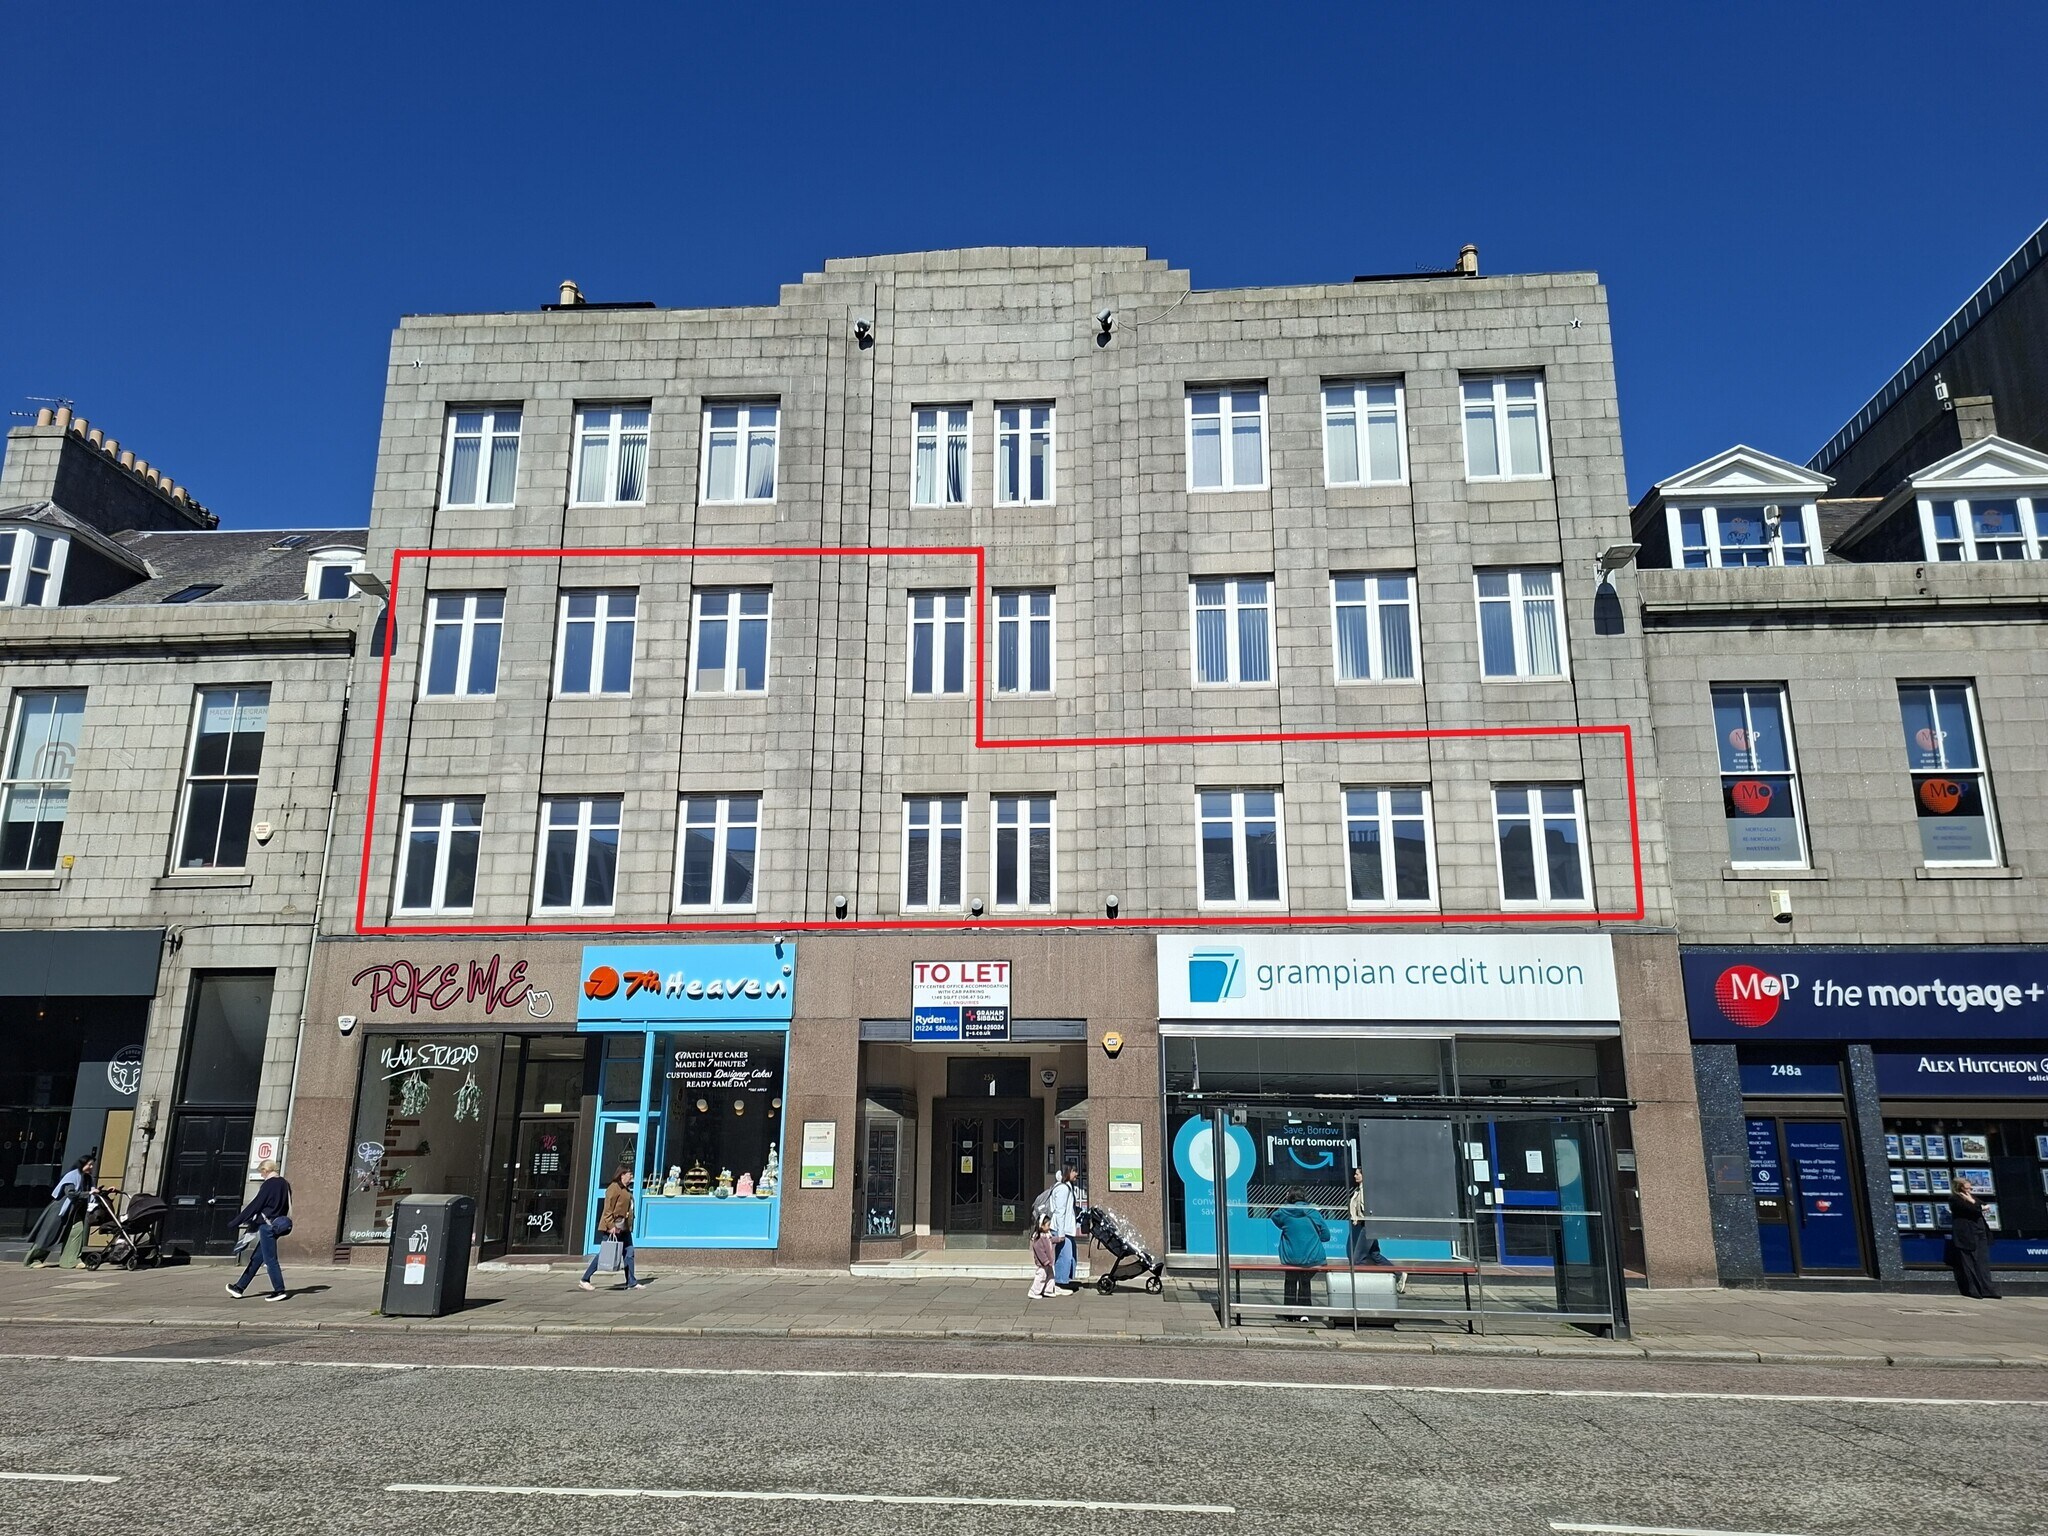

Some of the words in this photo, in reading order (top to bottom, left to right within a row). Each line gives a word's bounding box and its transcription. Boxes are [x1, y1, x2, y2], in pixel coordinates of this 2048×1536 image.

[915, 964, 951, 983] TO
[961, 963, 1008, 983] LET
[1257, 964, 1395, 991] grampian
[1405, 957, 1489, 985] credit
[1499, 959, 1584, 985] union
[352, 960, 463, 1014] POKE
[467, 953, 534, 1014] ME
[623, 970, 661, 998] 7th
[665, 970, 787, 998] Heaven
[1812, 979, 1863, 1007] the
[381, 1044, 418, 1059] NAIL
[417, 1043, 479, 1060] STUDIO
[707, 1059, 714, 1068] 7
[1771, 1065, 1802, 1076] 248a
[1918, 1057, 1956, 1072] ALEX
[1958, 1057, 2037, 1072] HUTCHEON
[666, 1071, 712, 1079] CUSTOMISED
[714, 1069, 751, 1082] Designer
[751, 1069, 773, 1078] Cakes
[1283, 1125, 1306, 1135] Save,
[1307, 1125, 1339, 1135] Borrow
[1291, 1136, 1305, 1146] for
